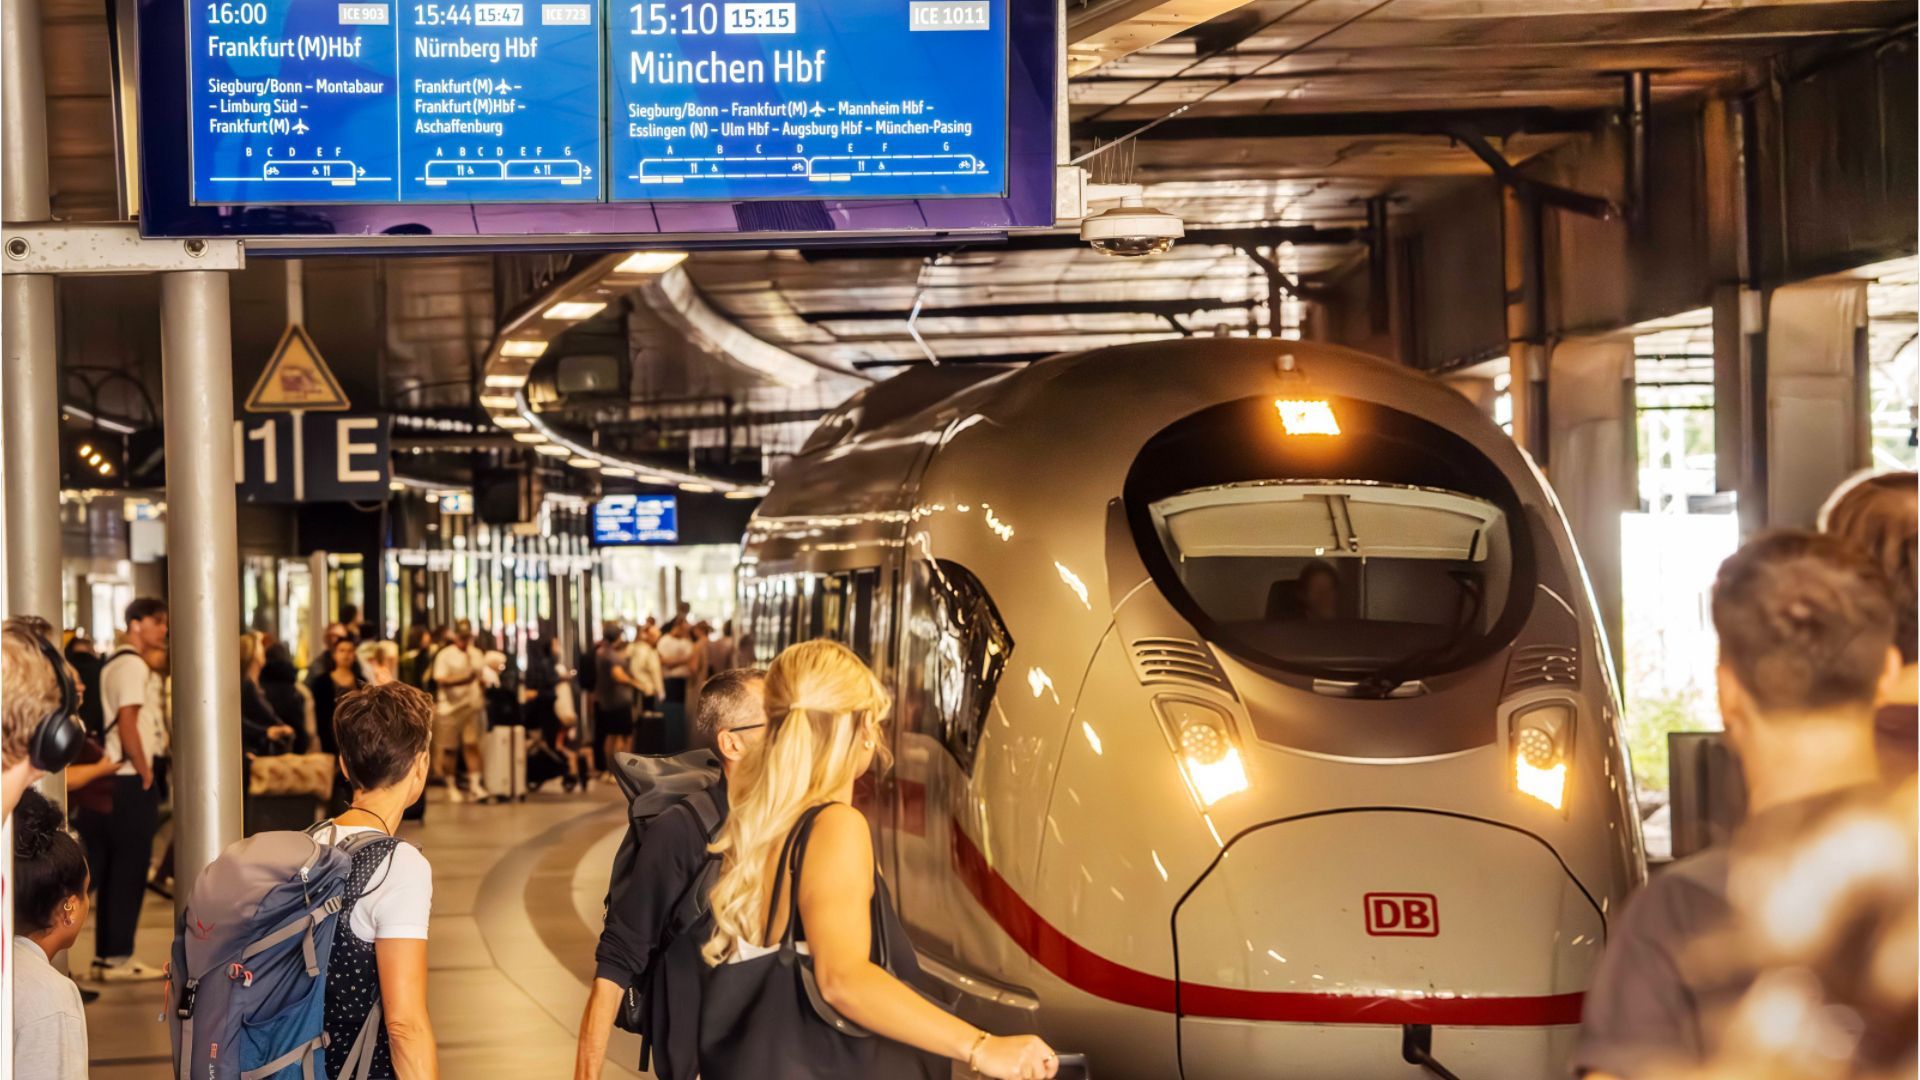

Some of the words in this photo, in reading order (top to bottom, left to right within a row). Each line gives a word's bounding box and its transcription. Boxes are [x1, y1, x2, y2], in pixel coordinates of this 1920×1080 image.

[208, 3, 267, 24] 16:00
[343, 8, 360, 20] ICE
[362, 8, 384, 20] 903
[414, 4, 471, 25] 15:44
[479, 8, 520, 22] 15:47
[546, 8, 562, 20] ICE
[565, 8, 586, 20] 723
[630, 3, 718, 35] 15:10
[732, 9, 789, 28] 15:15
[914, 7, 939, 24] ICE
[943, 6, 985, 24] 1011
[415, 37, 500, 63] Nürnberg
[505, 37, 538, 58] Hbf
[631, 50, 764, 84] München
[774, 50, 825, 83] Hbf
[208, 78, 302, 96] Siegburg/Bonn
[316, 79, 384, 93] Montabaur
[221, 99, 271, 115] Limburg
[274, 99, 297, 113] Süd
[629, 102, 718, 120] Siegburg/Bonn
[838, 101, 899, 115] Mannheim
[902, 100, 924, 114] Hbf
[415, 119, 503, 136] Aschaffenburg
[629, 123, 685, 140] Esslingen
[690, 122, 708, 138] (N)
[721, 122, 745, 136] Ulm
[748, 122, 769, 136] Hbf
[782, 121, 838, 139] Augsburg
[841, 120, 863, 135] Hbf
[876, 119, 972, 136] München-Pasing
[246, 147, 252, 157] B
[267, 147, 273, 157] C
[289, 147, 295, 157] D
[317, 147, 322, 157] E
[336, 147, 341, 157] F
[436, 147, 443, 156] A
[460, 147, 466, 156] B
[478, 147, 484, 156] C
[497, 147, 503, 156] D
[521, 147, 526, 156] E
[536, 147, 542, 156] F
[564, 147, 571, 156] G
[667, 145, 673, 155] A
[717, 145, 723, 154] B
[756, 144, 762, 154] C
[797, 144, 803, 153] D
[848, 143, 853, 152] E
[882, 143, 887, 152] F
[943, 142, 949, 151] G
[337, 418, 380, 482] E
[1373, 900, 1430, 929] DB
